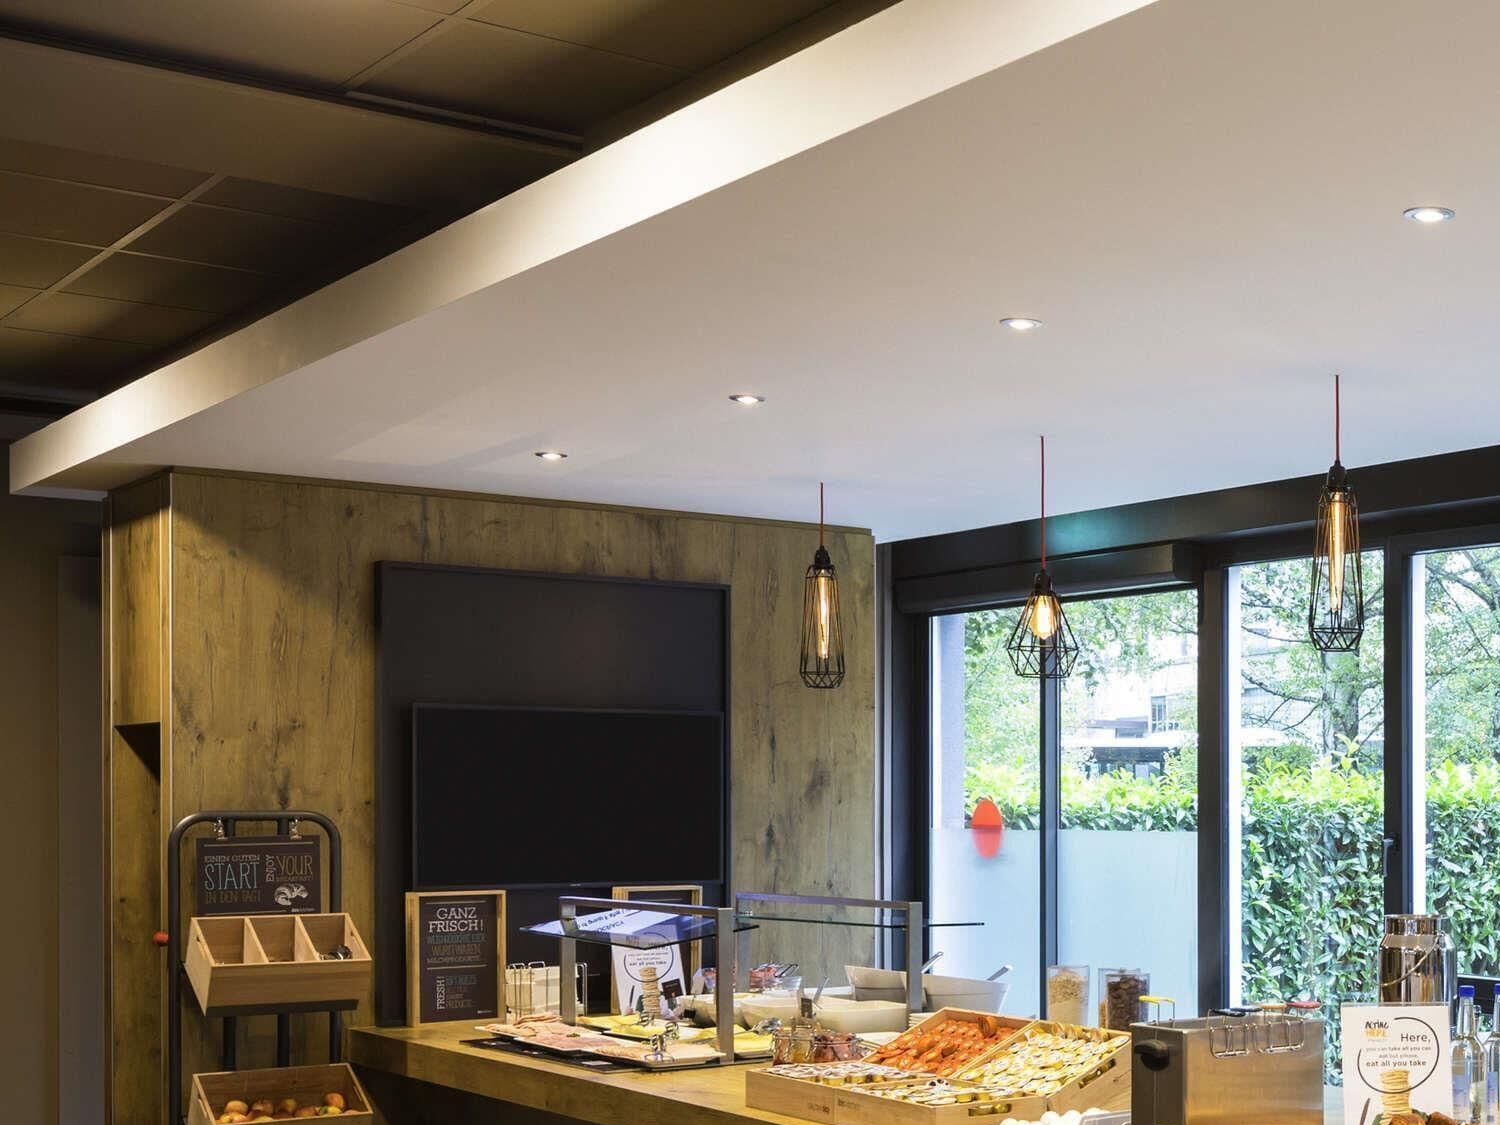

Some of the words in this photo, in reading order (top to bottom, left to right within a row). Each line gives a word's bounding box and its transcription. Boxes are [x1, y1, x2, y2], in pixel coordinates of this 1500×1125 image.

[276, 855, 313, 876] YOUR
[204, 862, 260, 890] START
[436, 907, 477, 920] GANZ
[436, 976, 446, 1010] FRESH!
[1400, 1032, 1432, 1044] Here,
[1392, 1060, 1407, 1068] you
